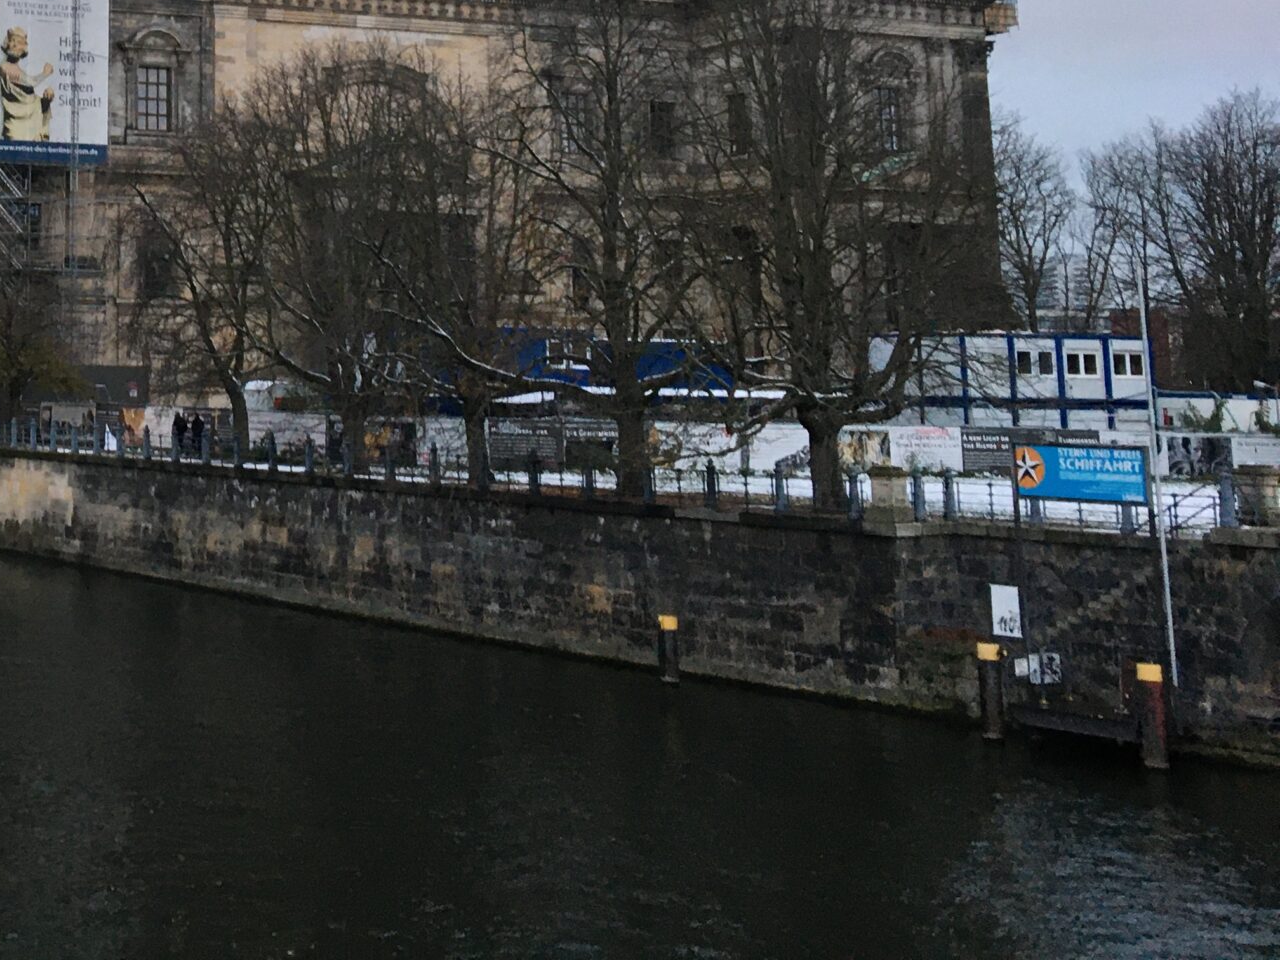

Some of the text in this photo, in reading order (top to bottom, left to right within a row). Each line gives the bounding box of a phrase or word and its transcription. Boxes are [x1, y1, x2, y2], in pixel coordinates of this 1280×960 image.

[52, 4, 91, 13] STIFNG
[59, 50, 95, 63] hefen
[58, 82, 93, 93] reen
[1058, 447, 1142, 460] STERN UND KREIS
[1058, 458, 1141, 473] SCHIFFAHRT
